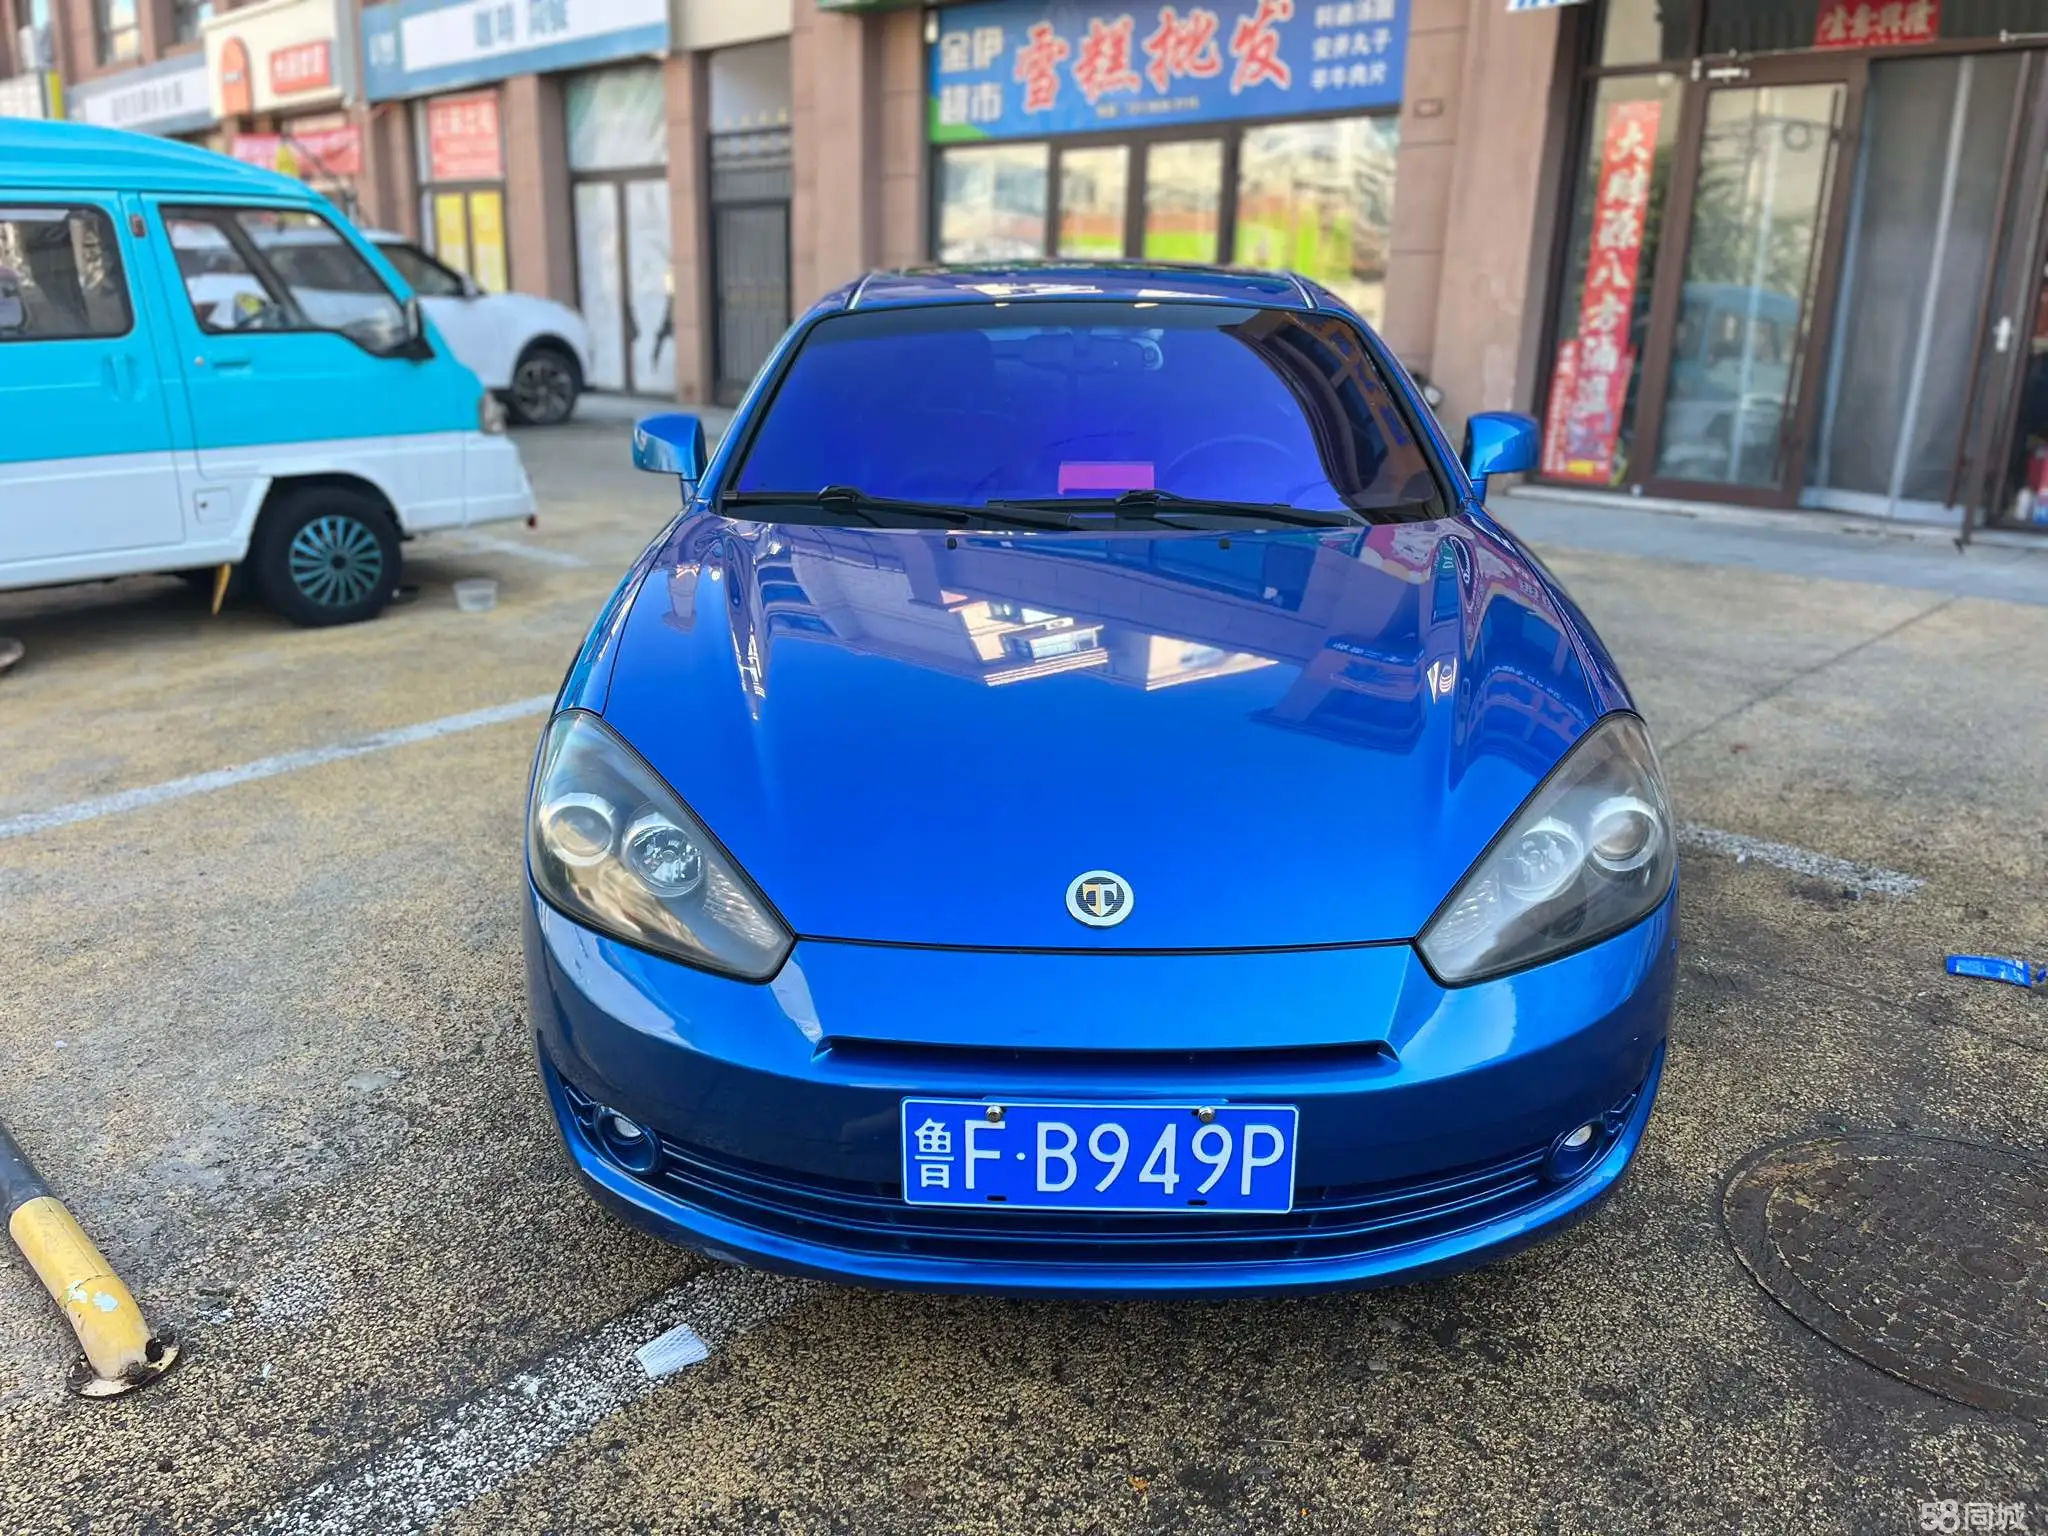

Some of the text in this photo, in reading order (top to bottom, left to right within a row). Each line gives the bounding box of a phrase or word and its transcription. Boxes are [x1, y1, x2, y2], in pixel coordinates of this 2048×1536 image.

[1013, 0, 1293, 115] 雪糕批发
[941, 82, 1002, 126] 超市
